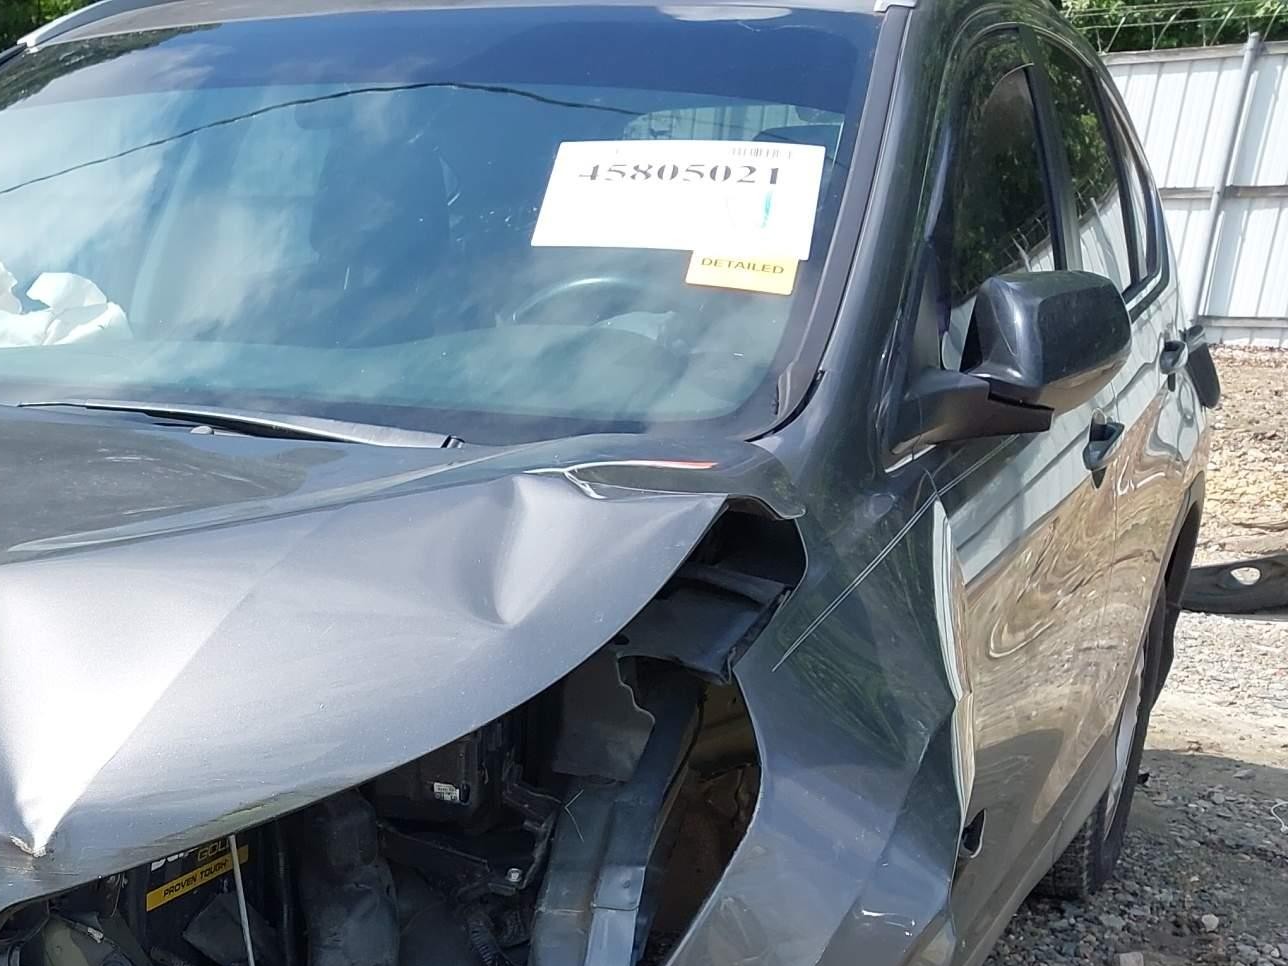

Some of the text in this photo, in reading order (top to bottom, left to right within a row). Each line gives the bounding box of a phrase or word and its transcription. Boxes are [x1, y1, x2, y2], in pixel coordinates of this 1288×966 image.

[578, 164, 779, 185] 45805021
[701, 257, 785, 275] DETAILED
[163, 860, 227, 897] PROVEN TOUGH
